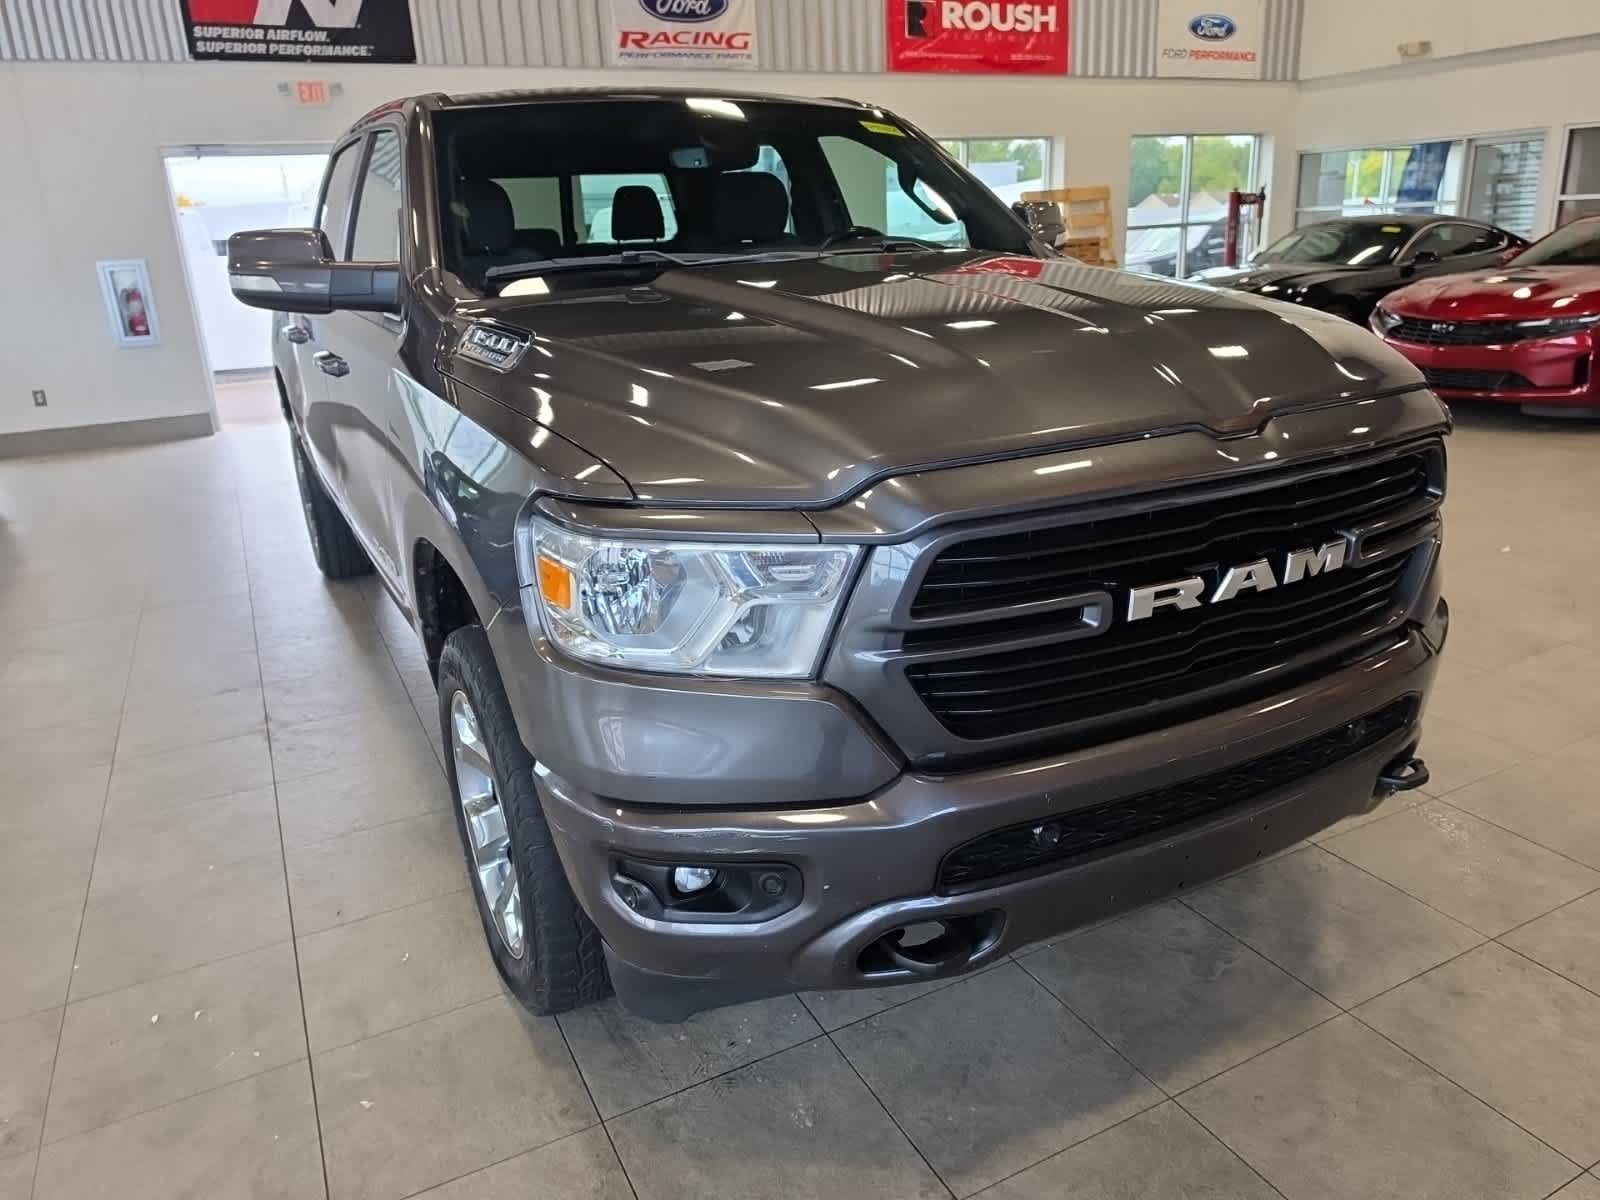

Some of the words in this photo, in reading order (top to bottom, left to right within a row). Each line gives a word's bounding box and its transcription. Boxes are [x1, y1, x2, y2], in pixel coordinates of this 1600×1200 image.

[941, 1, 1057, 33] ROUSH
[1197, 16, 1230, 37] Ford
[193, 26, 265, 40] SUPERIOR
[266, 29, 331, 42] AIRFLOW.
[619, 31, 752, 50] RACING
[196, 41, 267, 54] SUPERIOR
[1127, 537, 1347, 622] RAM
